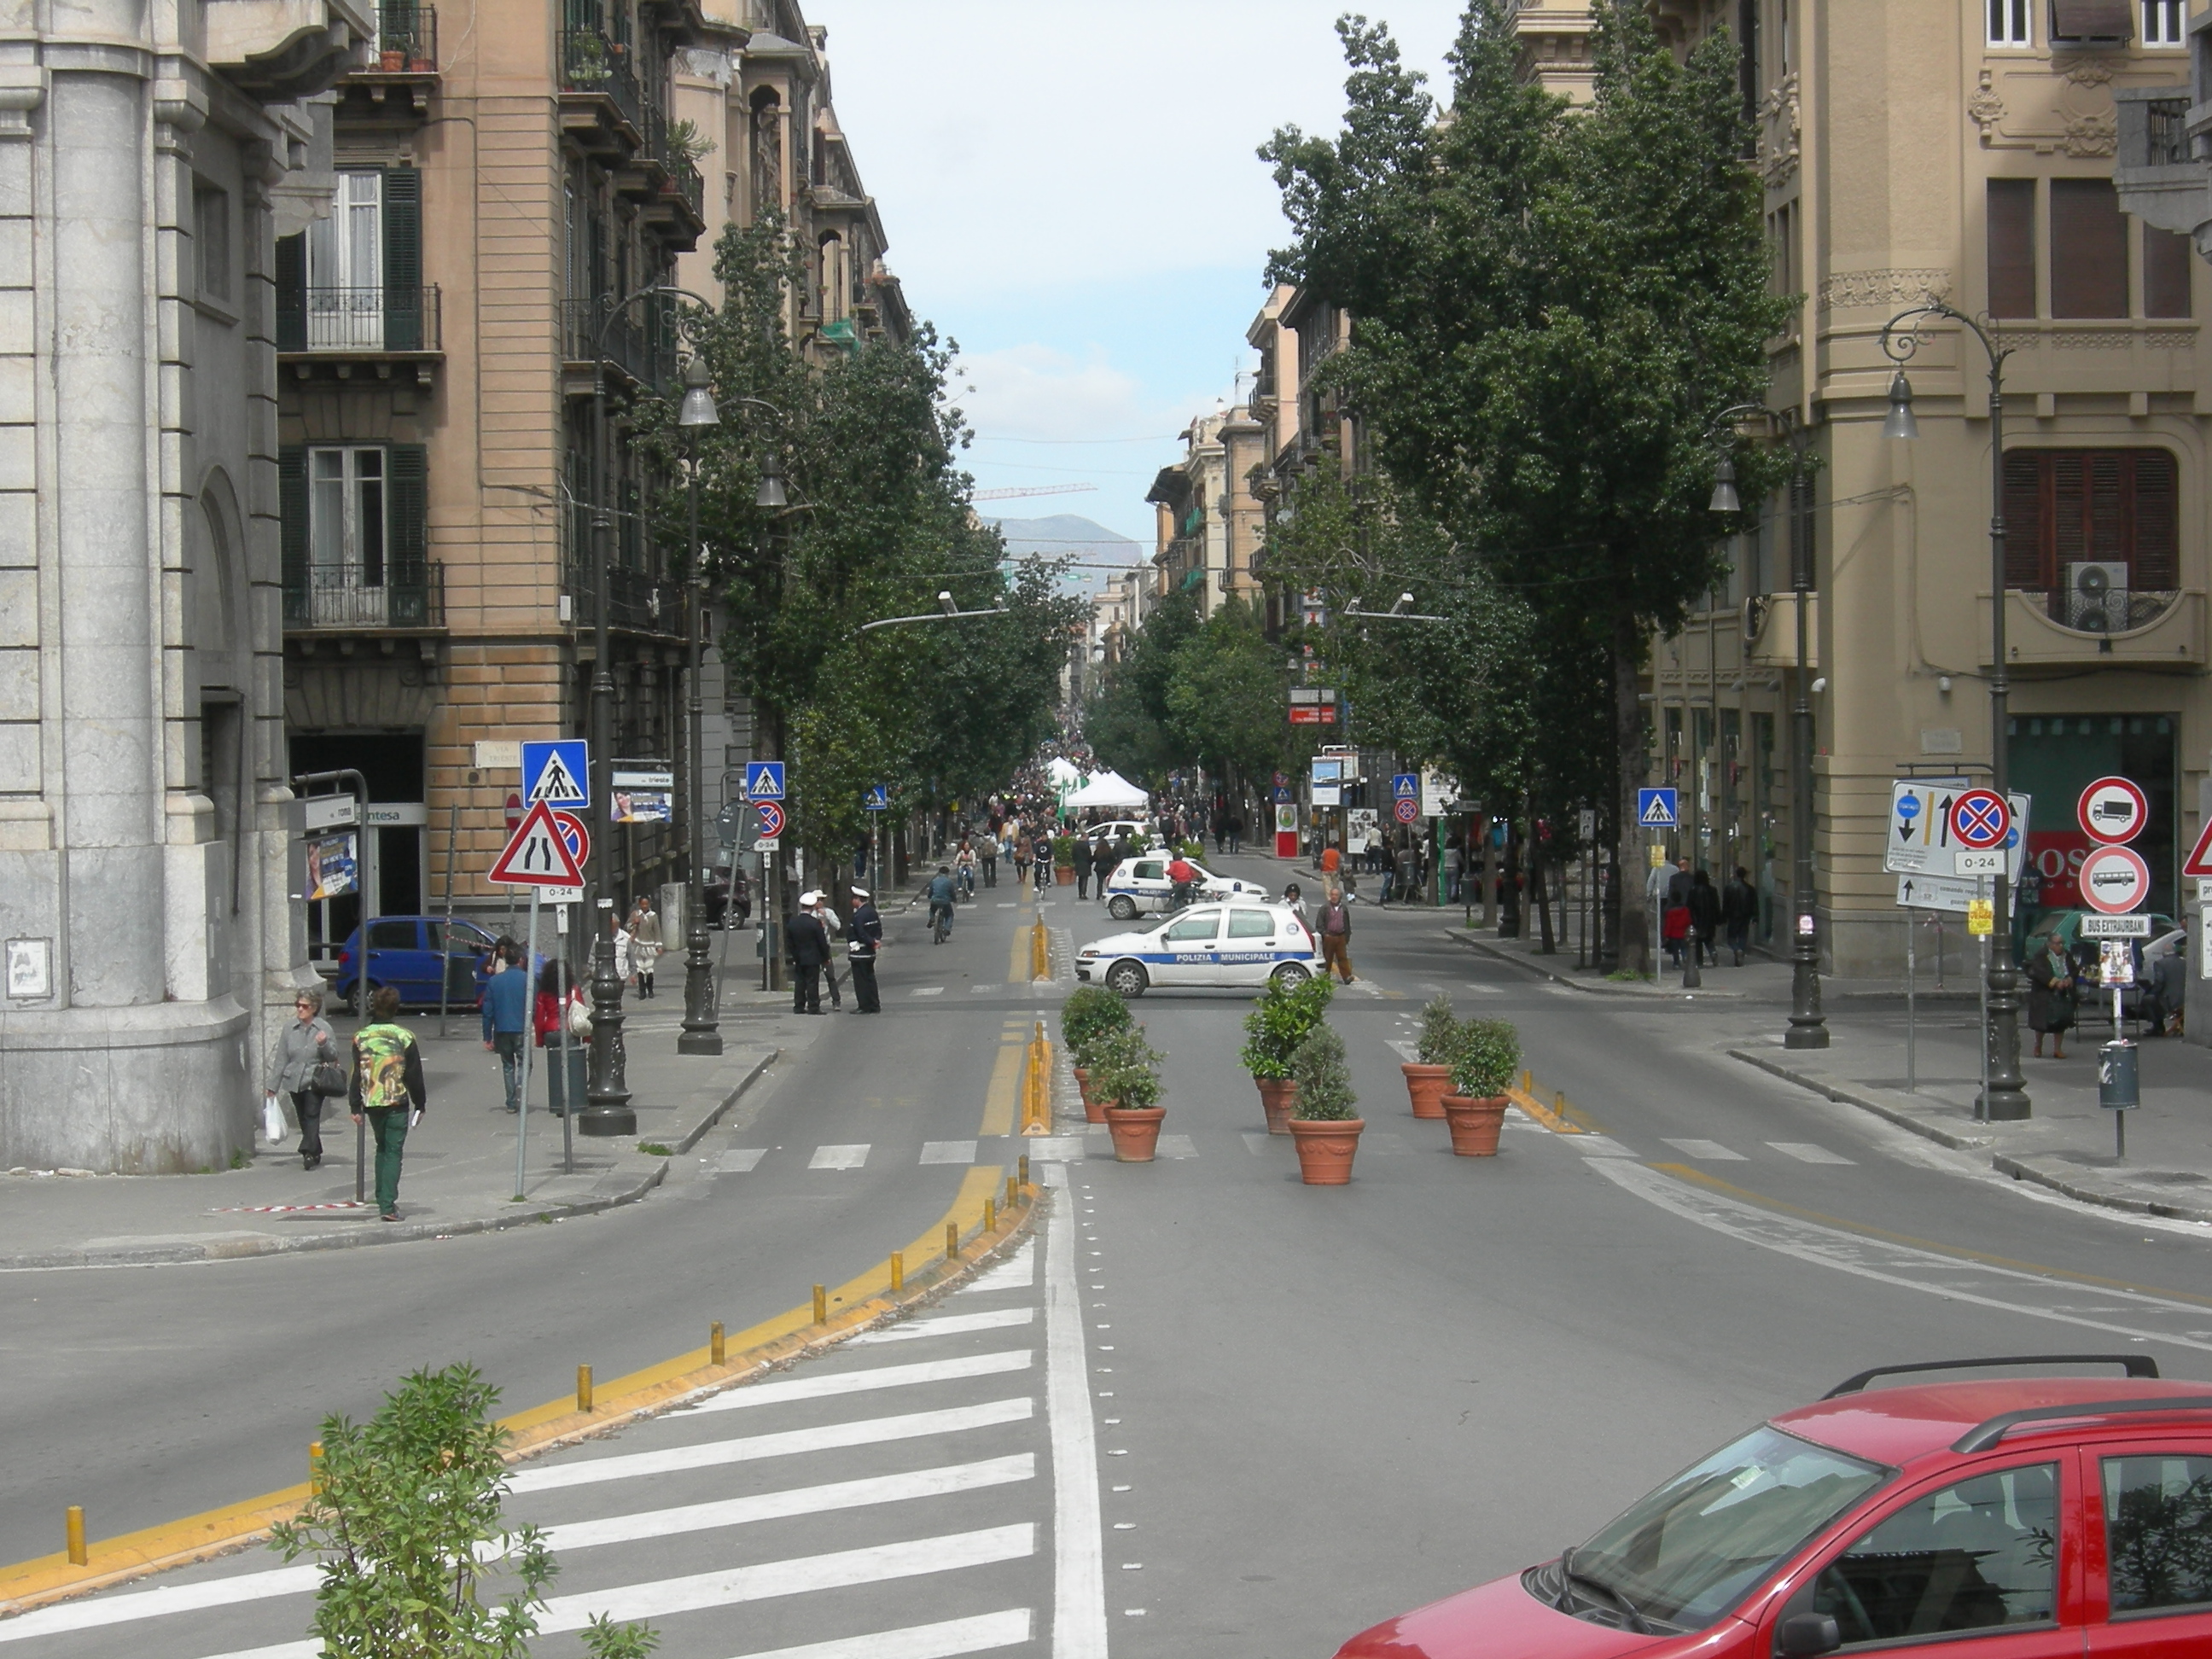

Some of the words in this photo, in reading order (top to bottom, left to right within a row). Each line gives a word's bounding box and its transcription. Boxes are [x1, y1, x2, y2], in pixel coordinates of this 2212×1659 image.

[365, 809, 400, 821] ntesa
[1964, 858, 1995, 869] 0-24
[549, 888, 573, 897] 0-24
[2087, 919, 2100, 933] BUS
[2102, 919, 2145, 933] EXTRAURBANI
[1176, 953, 1212, 962] POLIZIA
[1220, 952, 1276, 961] MUNICIPALE
